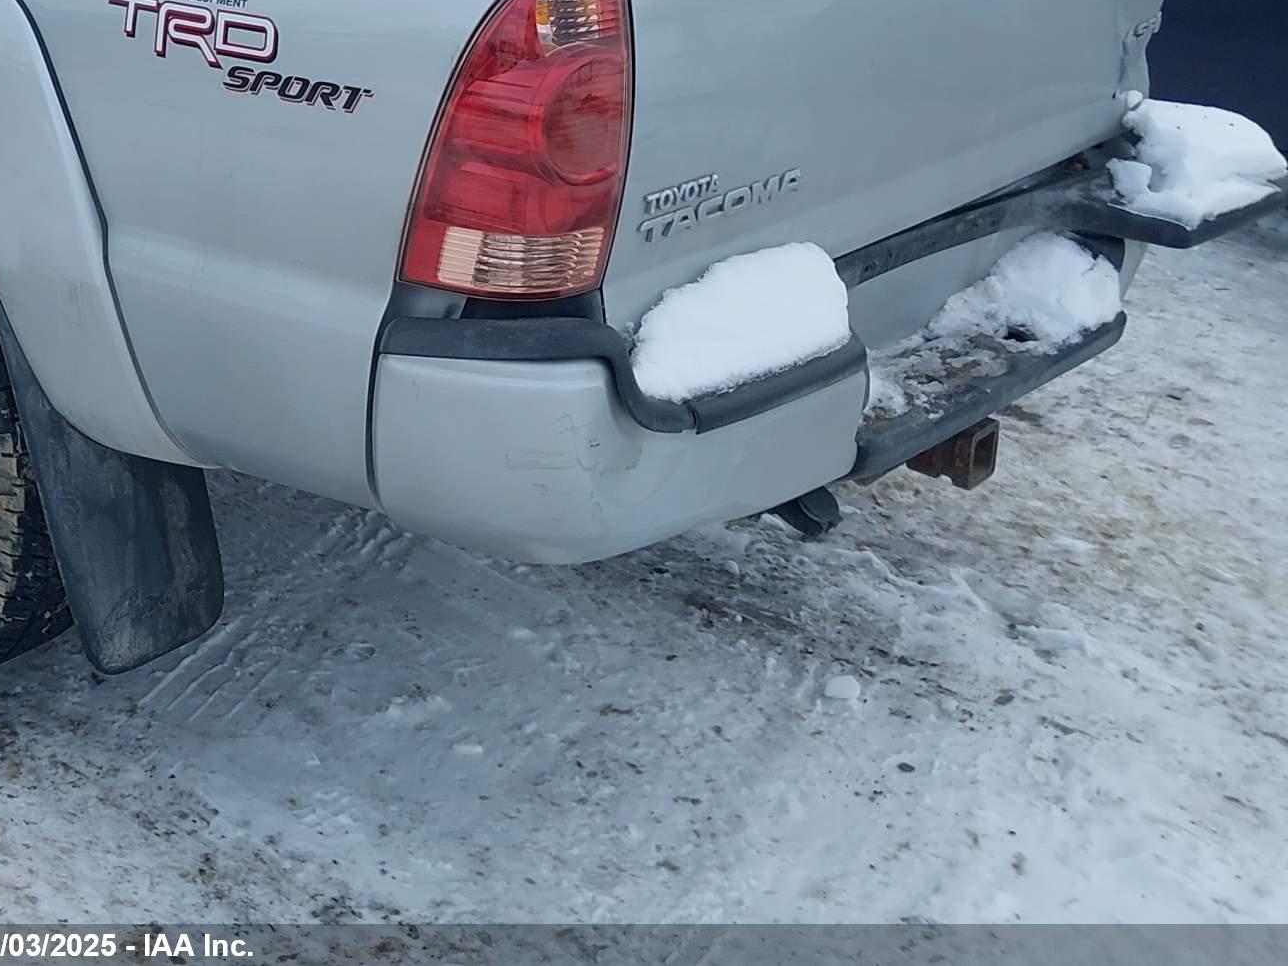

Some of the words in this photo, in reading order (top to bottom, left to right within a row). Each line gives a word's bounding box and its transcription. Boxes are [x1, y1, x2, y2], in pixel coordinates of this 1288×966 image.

[222, 65, 374, 114] SPORT
[636, 167, 802, 243] TACOMA
[644, 172, 720, 215] TOYOTA
